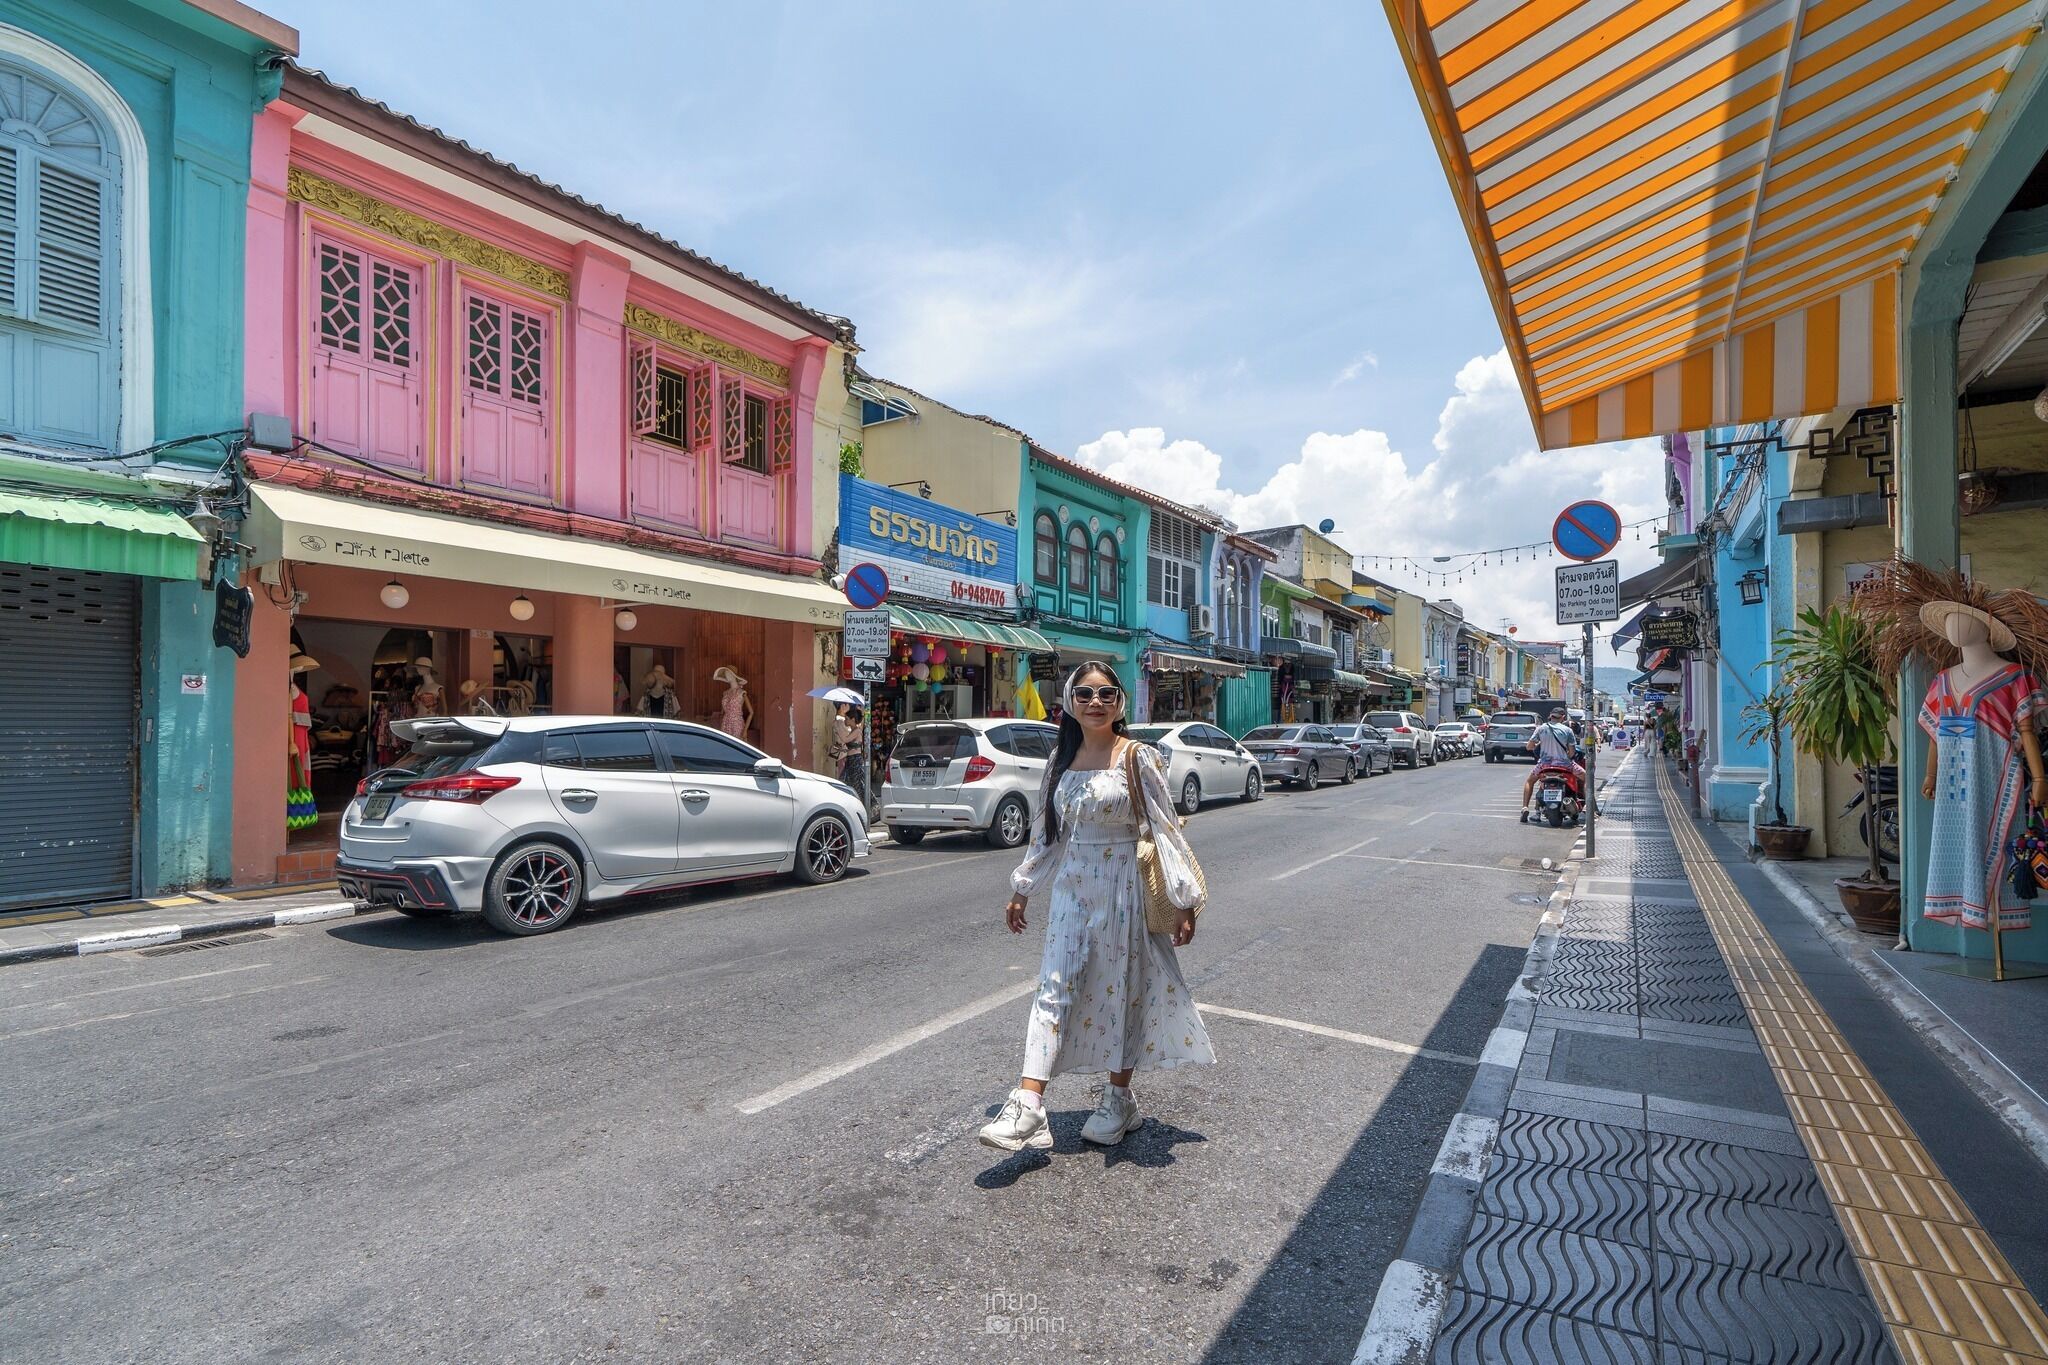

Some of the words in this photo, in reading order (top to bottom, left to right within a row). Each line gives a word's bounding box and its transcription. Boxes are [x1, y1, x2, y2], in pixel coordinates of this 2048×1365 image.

[869, 505, 999, 566] ธรรมจักร
[1559, 562, 1615, 584] ห้ามจอดวันคี่
[951, 580, 1005, 607] 06-9487476
[1559, 584, 1615, 599] 07.00-19.00
[846, 614, 888, 628] ห้ามจอดวันคู่
[1560, 610, 1573, 620] 7.00
[846, 627, 888, 636] 07.00-19.00
